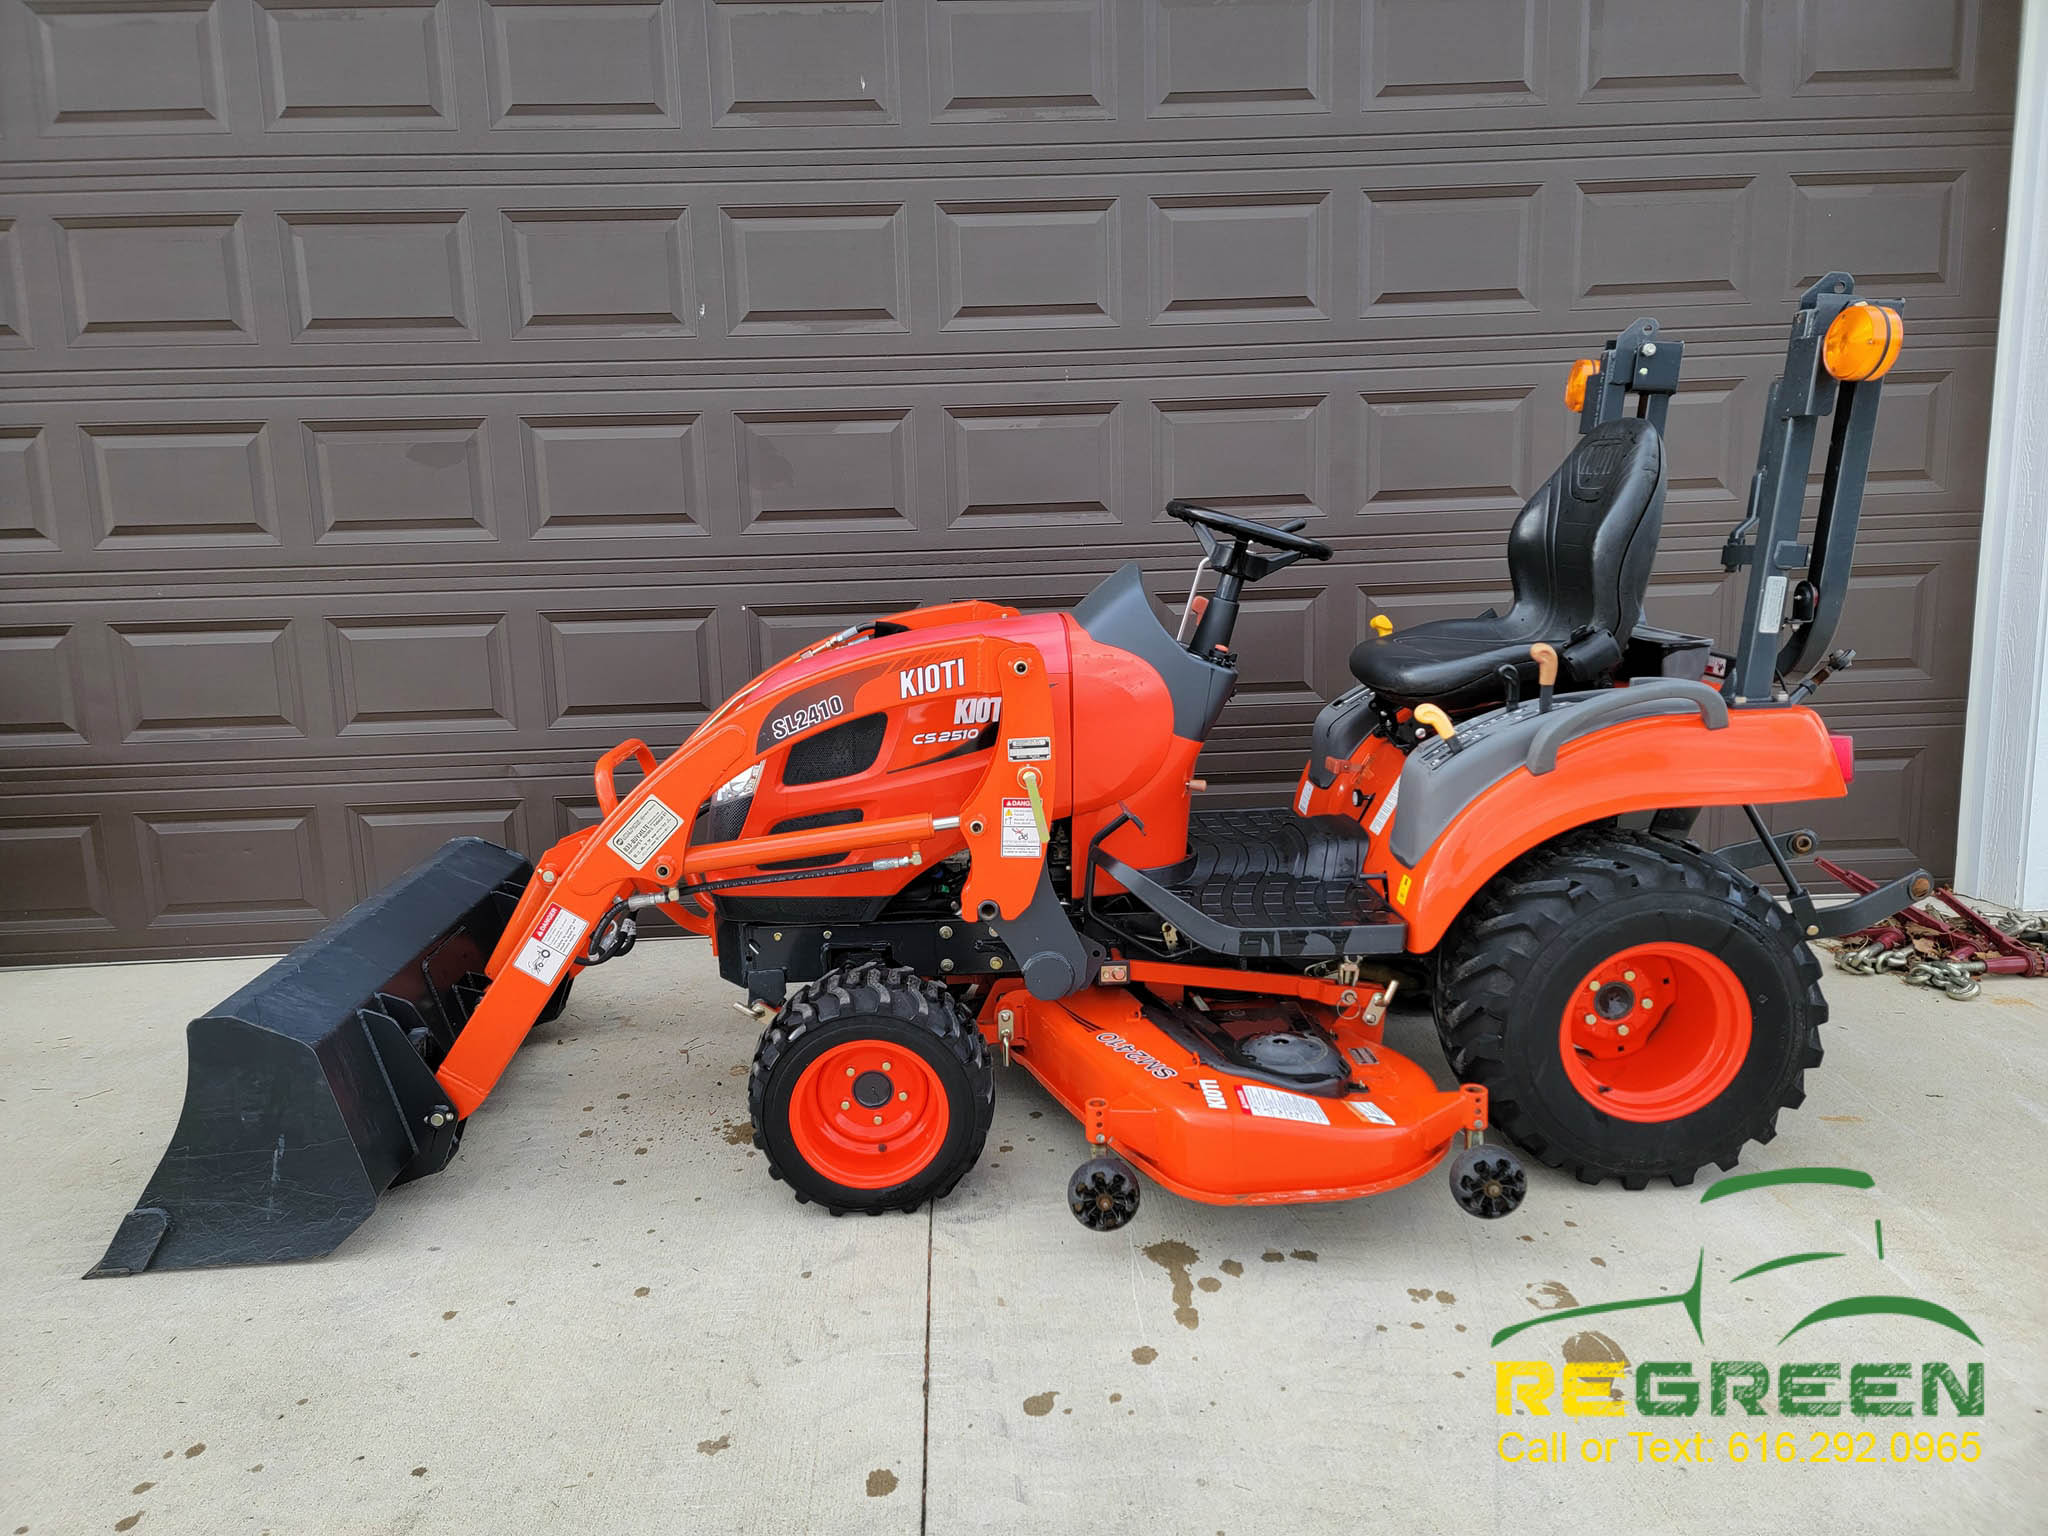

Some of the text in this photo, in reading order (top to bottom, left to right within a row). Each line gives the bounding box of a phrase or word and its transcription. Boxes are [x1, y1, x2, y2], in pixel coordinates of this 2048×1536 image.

[900, 658, 966, 699] KIOTI
[772, 695, 844, 740] SL2410
[953, 696, 1002, 725] KIOT
[1096, 1032, 1178, 1080] SM2410
[1199, 1079, 1228, 1110] KIOTI
